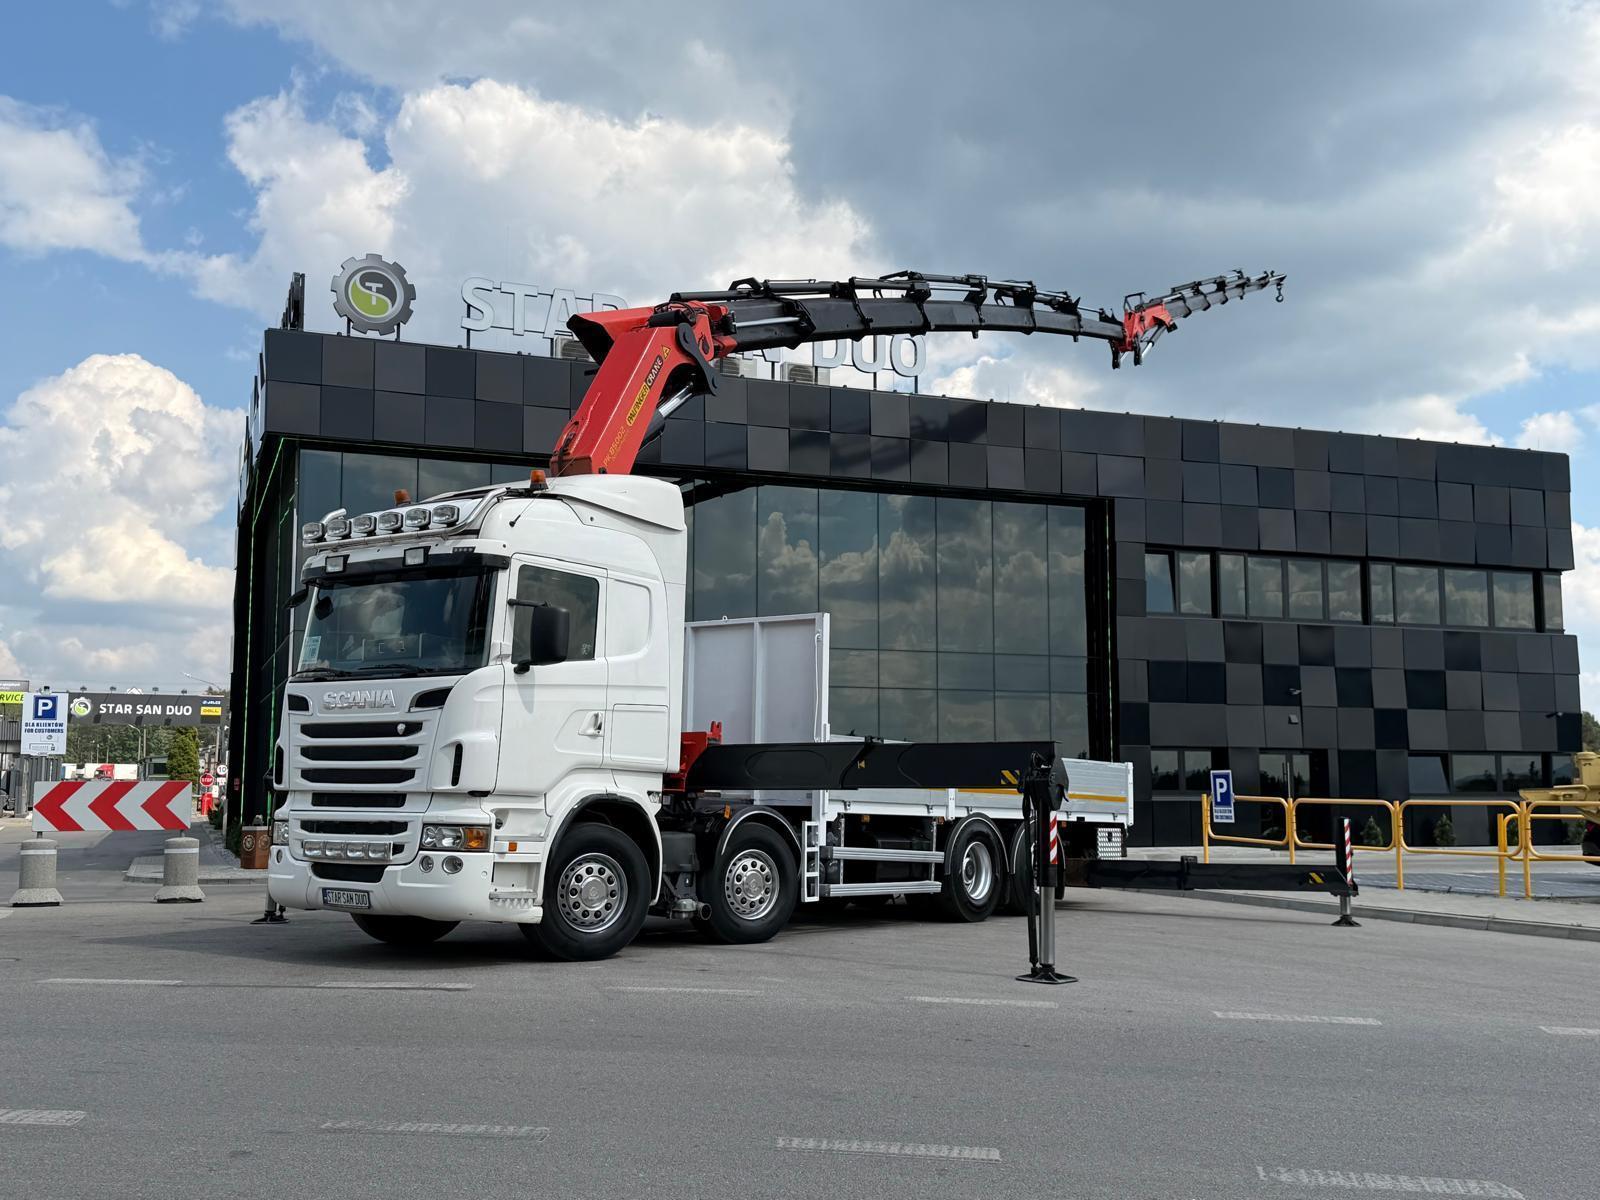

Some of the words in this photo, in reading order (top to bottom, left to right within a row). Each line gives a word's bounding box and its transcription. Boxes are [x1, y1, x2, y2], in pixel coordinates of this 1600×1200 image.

[627, 384, 649, 425] PALFINGER
[646, 356, 664, 386] CRANE
[38, 699, 53, 716] P
[323, 689, 396, 709] SCANIA
[99, 703, 132, 714] STAR
[136, 704, 161, 715] SAN
[166, 705, 192, 716] DUO
[1215, 778, 1227, 802] P
[327, 890, 342, 904] STAR
[342, 892, 355, 905] SAN
[355, 893, 368, 906] DUO
